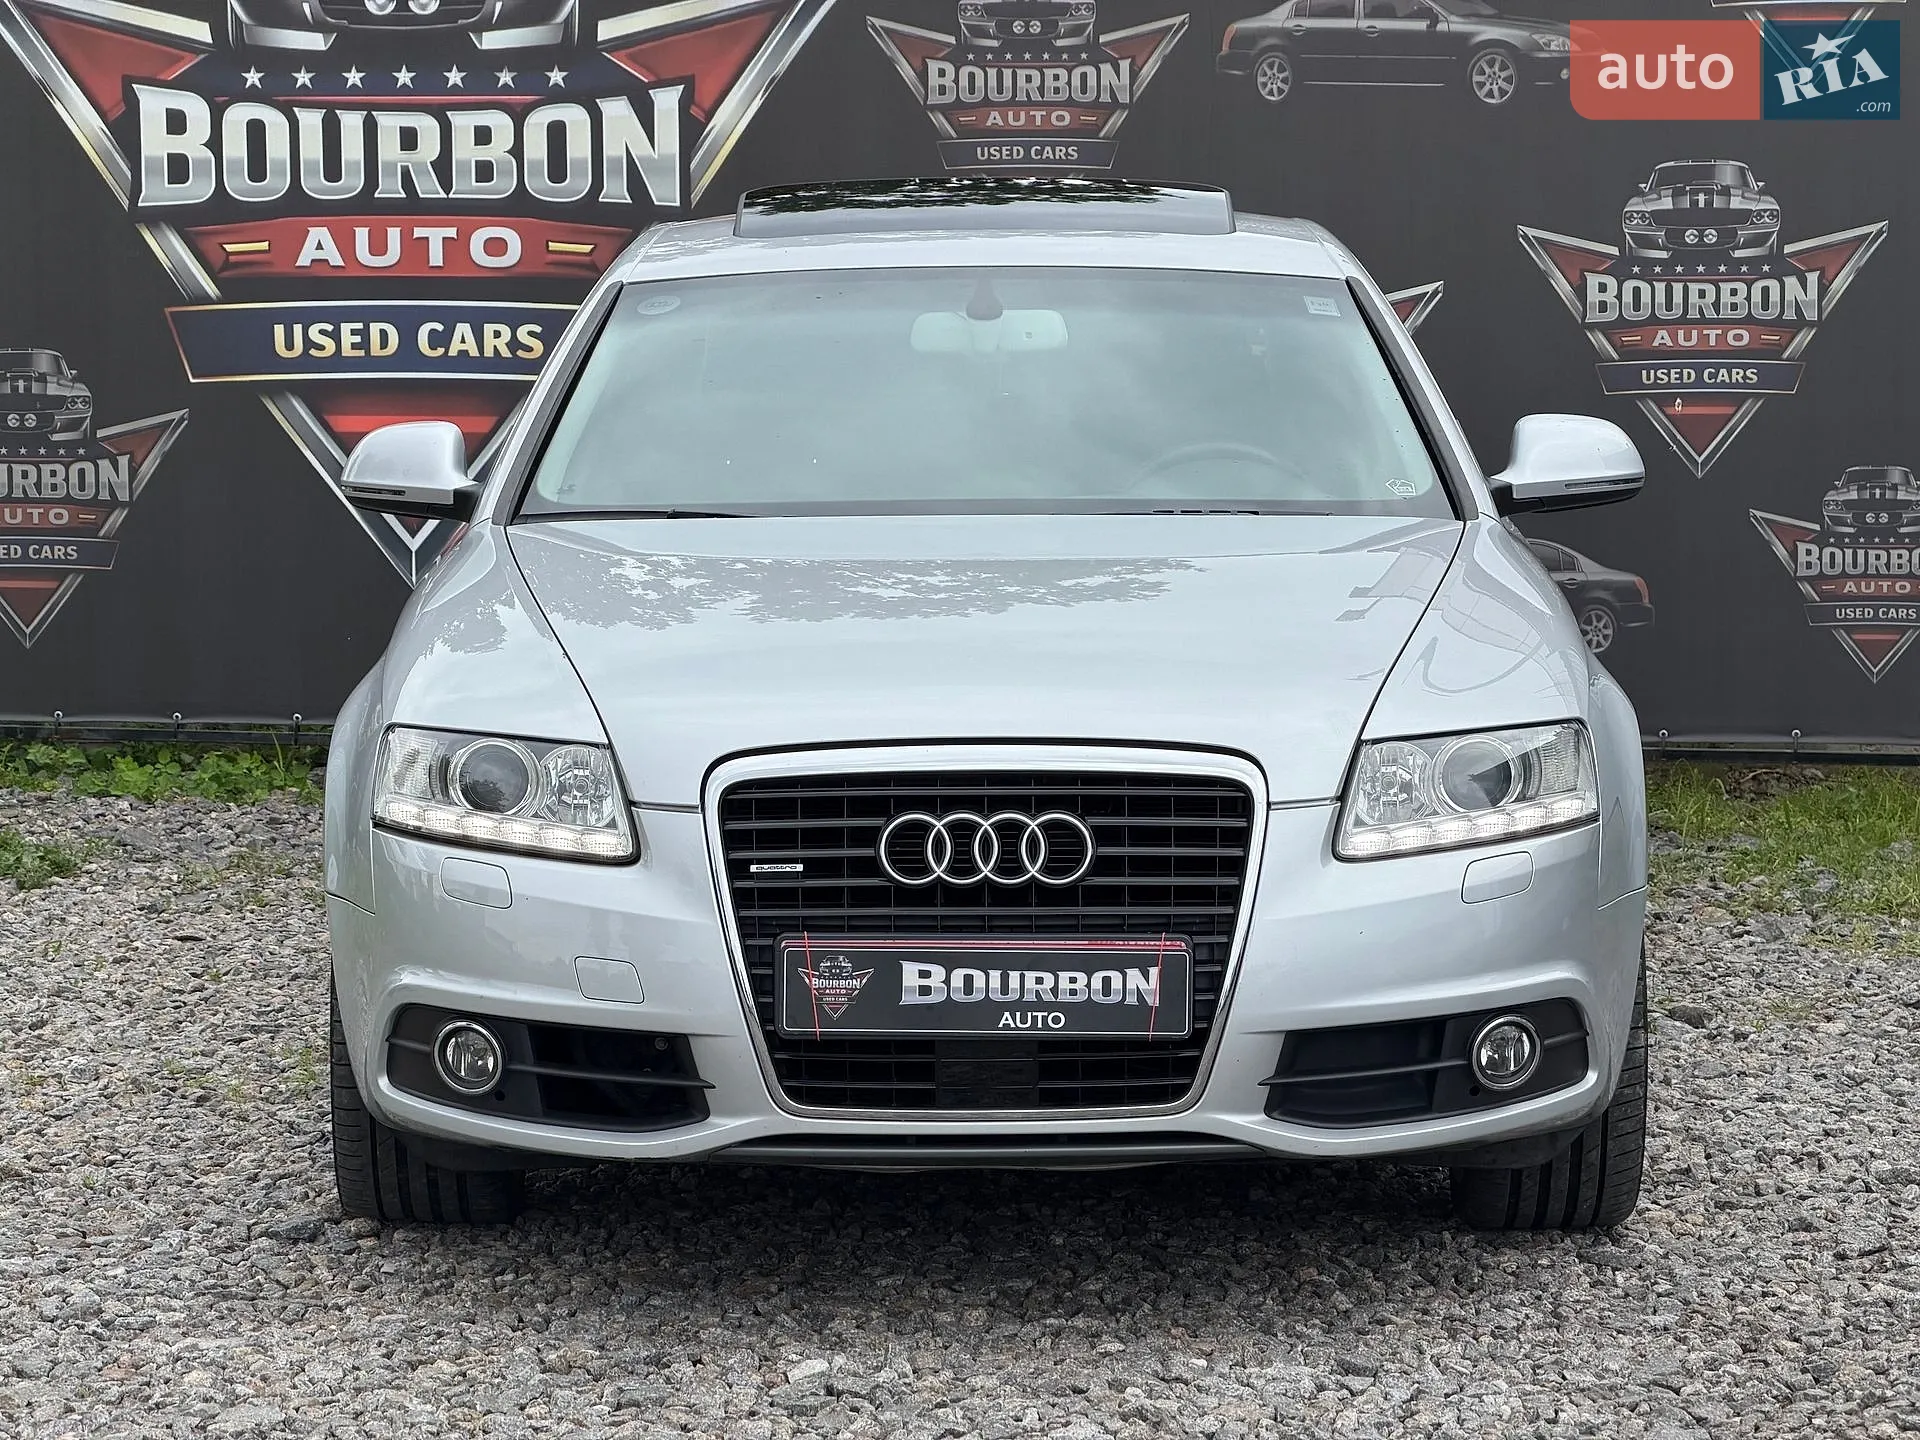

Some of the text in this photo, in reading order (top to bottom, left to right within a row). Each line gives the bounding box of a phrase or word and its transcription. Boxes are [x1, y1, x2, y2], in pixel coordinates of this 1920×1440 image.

[925, 59, 1132, 105] BOURBON
[985, 111, 1072, 127] AUTO
[131, 83, 685, 207] BOURBON
[976, 146, 1079, 161] USED CARS
[295, 227, 523, 268] AUTO
[1584, 272, 1820, 322] BOURBON
[273, 322, 544, 360] USED CARS
[1651, 329, 1750, 347] AUTO
[1641, 368, 1758, 384] USED CARS
[0, 507, 69, 525] UTO
[28, 544, 78, 560] CARS
[1842, 581, 1911, 594] AUTO
[1835, 607, 1917, 620] USED CARS
[812, 977, 861, 989] BOURBON
[899, 960, 1161, 1007] BOURBON
[998, 1011, 1066, 1029] AUTO
